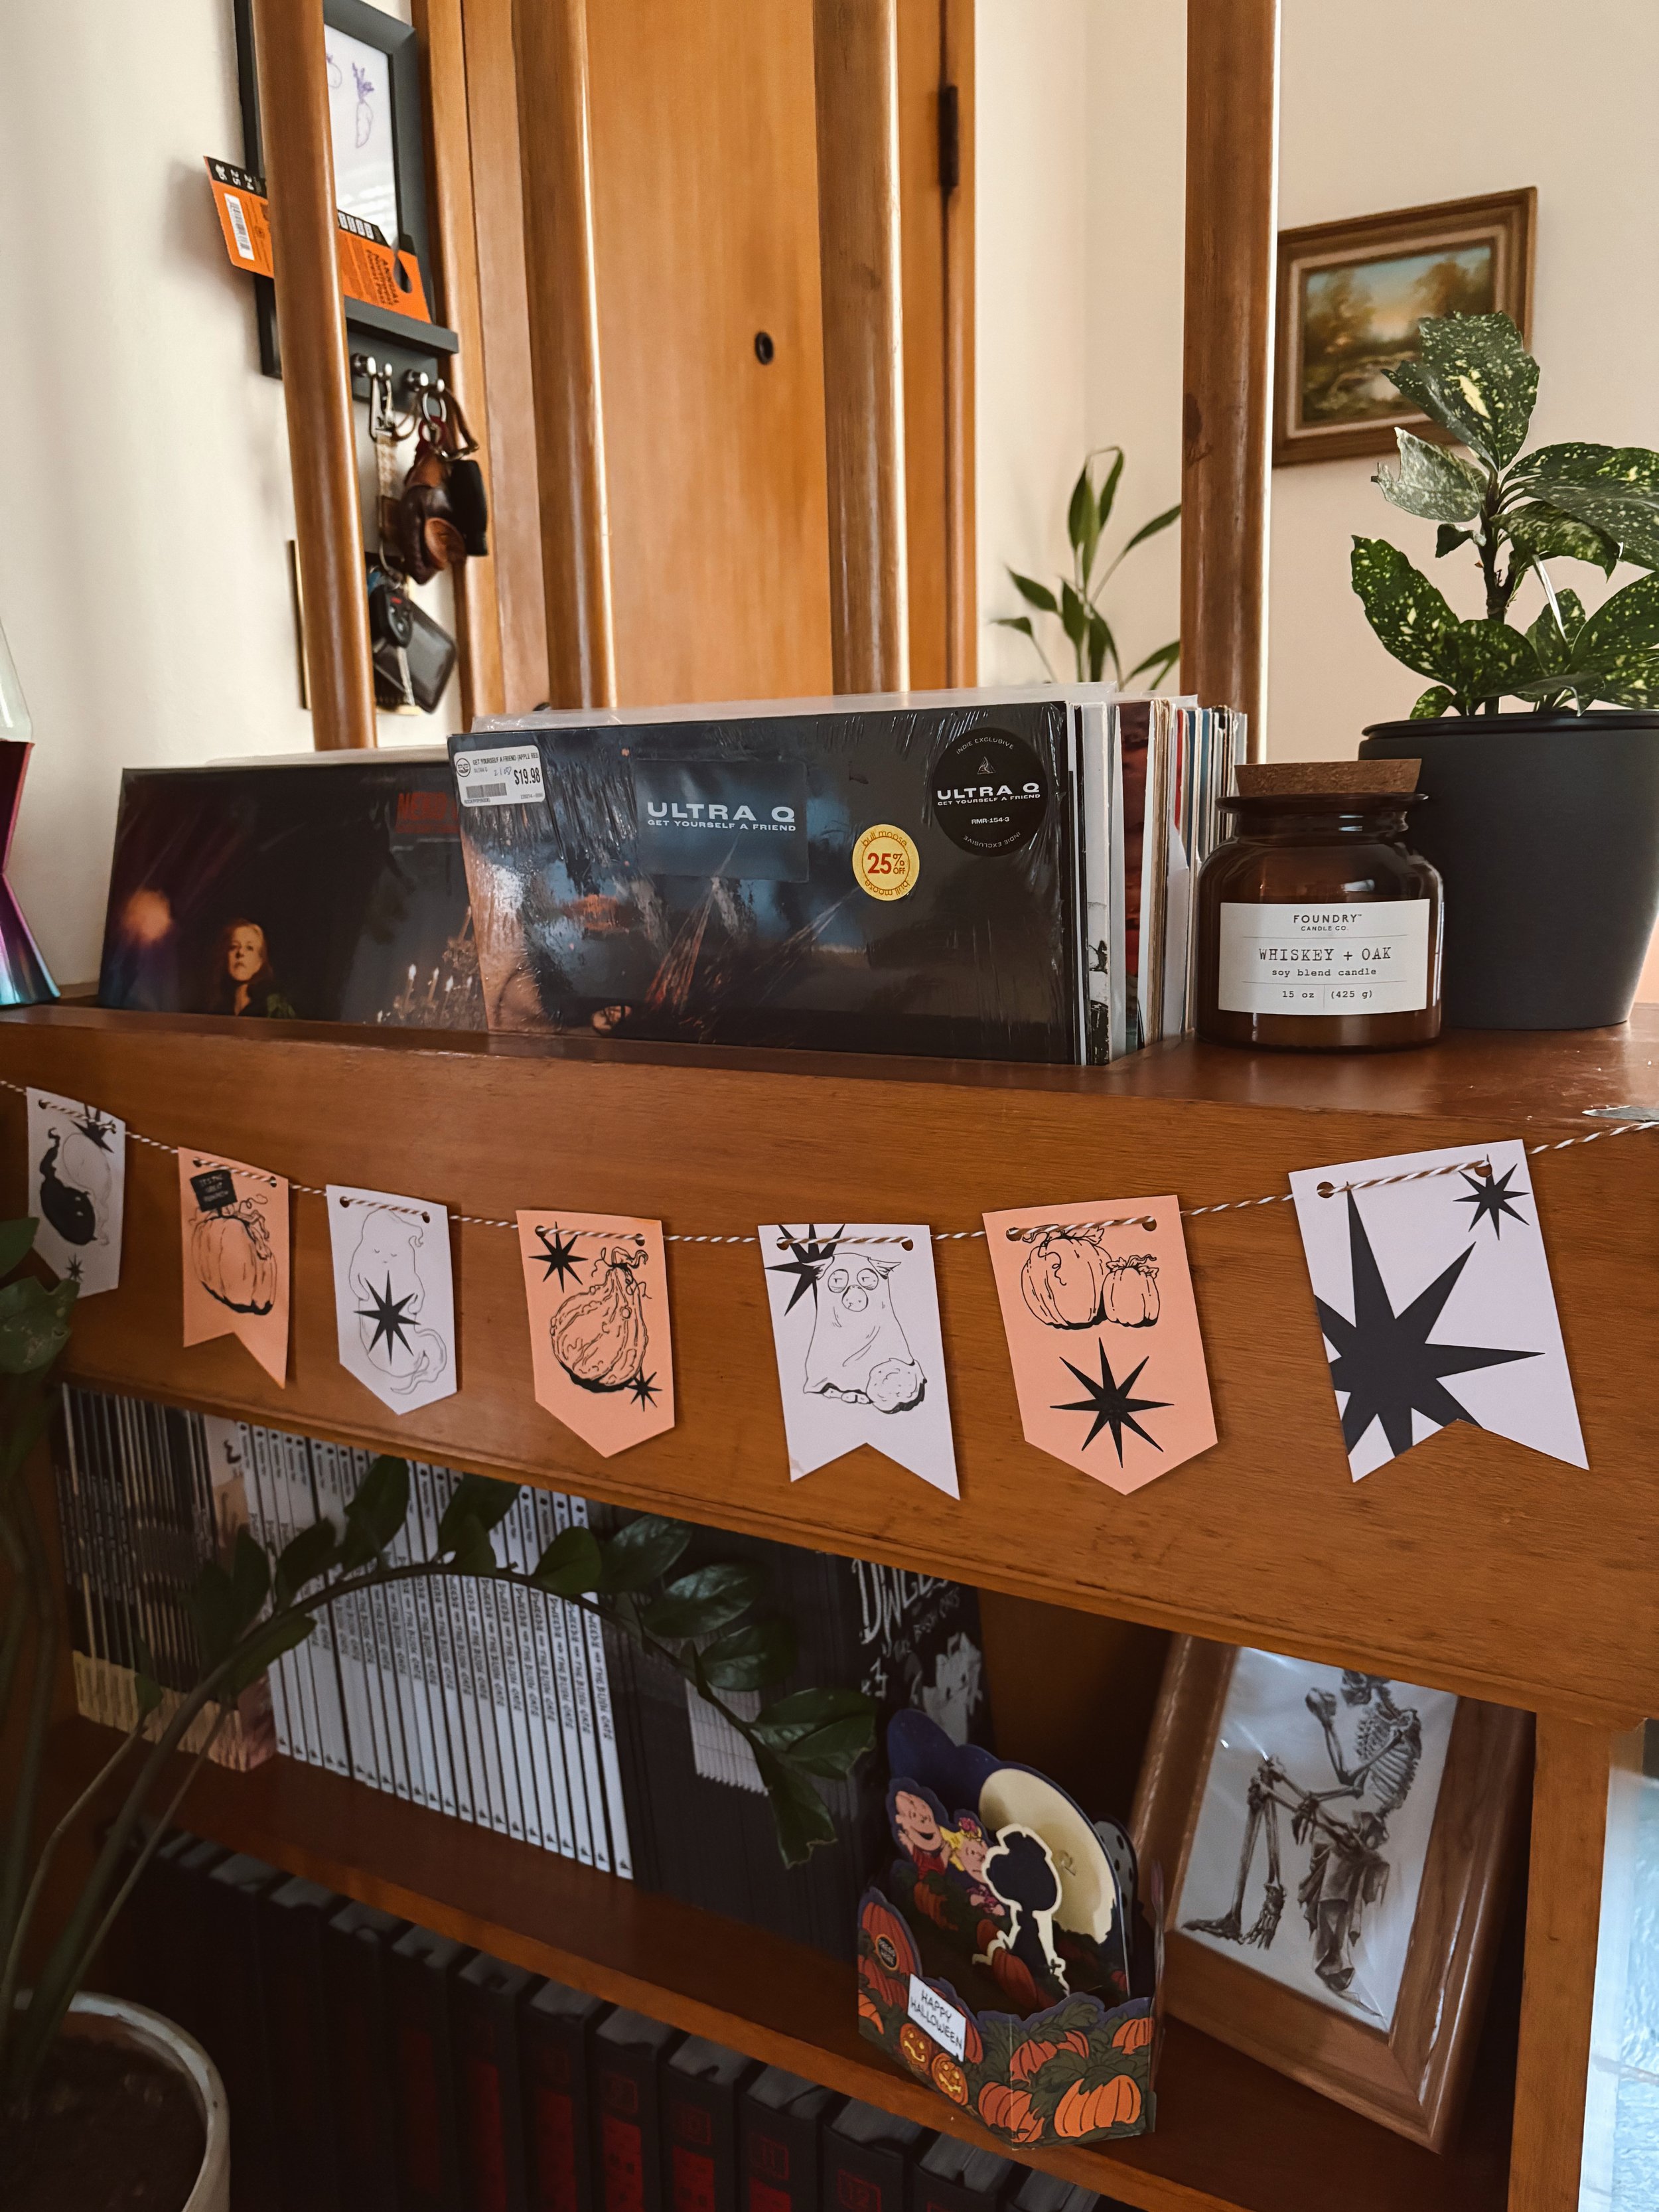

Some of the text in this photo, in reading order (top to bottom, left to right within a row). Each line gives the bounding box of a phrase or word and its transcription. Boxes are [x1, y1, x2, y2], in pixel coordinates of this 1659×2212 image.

[230, 169, 242, 186] 25
[244, 174, 255, 190] 24
[956, 737, 1014, 755] INDIE EXCLUSIVE
[514, 767, 541, 786] $19.98
[937, 782, 1040, 800] ULTRA Q
[647, 802, 795, 823] ULTRA Q
[972, 816, 1010, 825] RMR-154-3
[674, 820, 735, 829] YOURSELF
[861, 831, 907, 847] bull moose
[963, 832, 1020, 848] INDIE EXCLUSIVE
[865, 879, 910, 896] bull moose
[1259, 947, 1392, 962] WHISKEY + OAK
[1271, 968, 1377, 978] soy blend candle
[1331, 990, 1356, 999] (425
[1362, 990, 1373, 999] g)
[921, 1989, 952, 2022] HAPPY
[910, 1996, 962, 2050] HALLOWEEN
